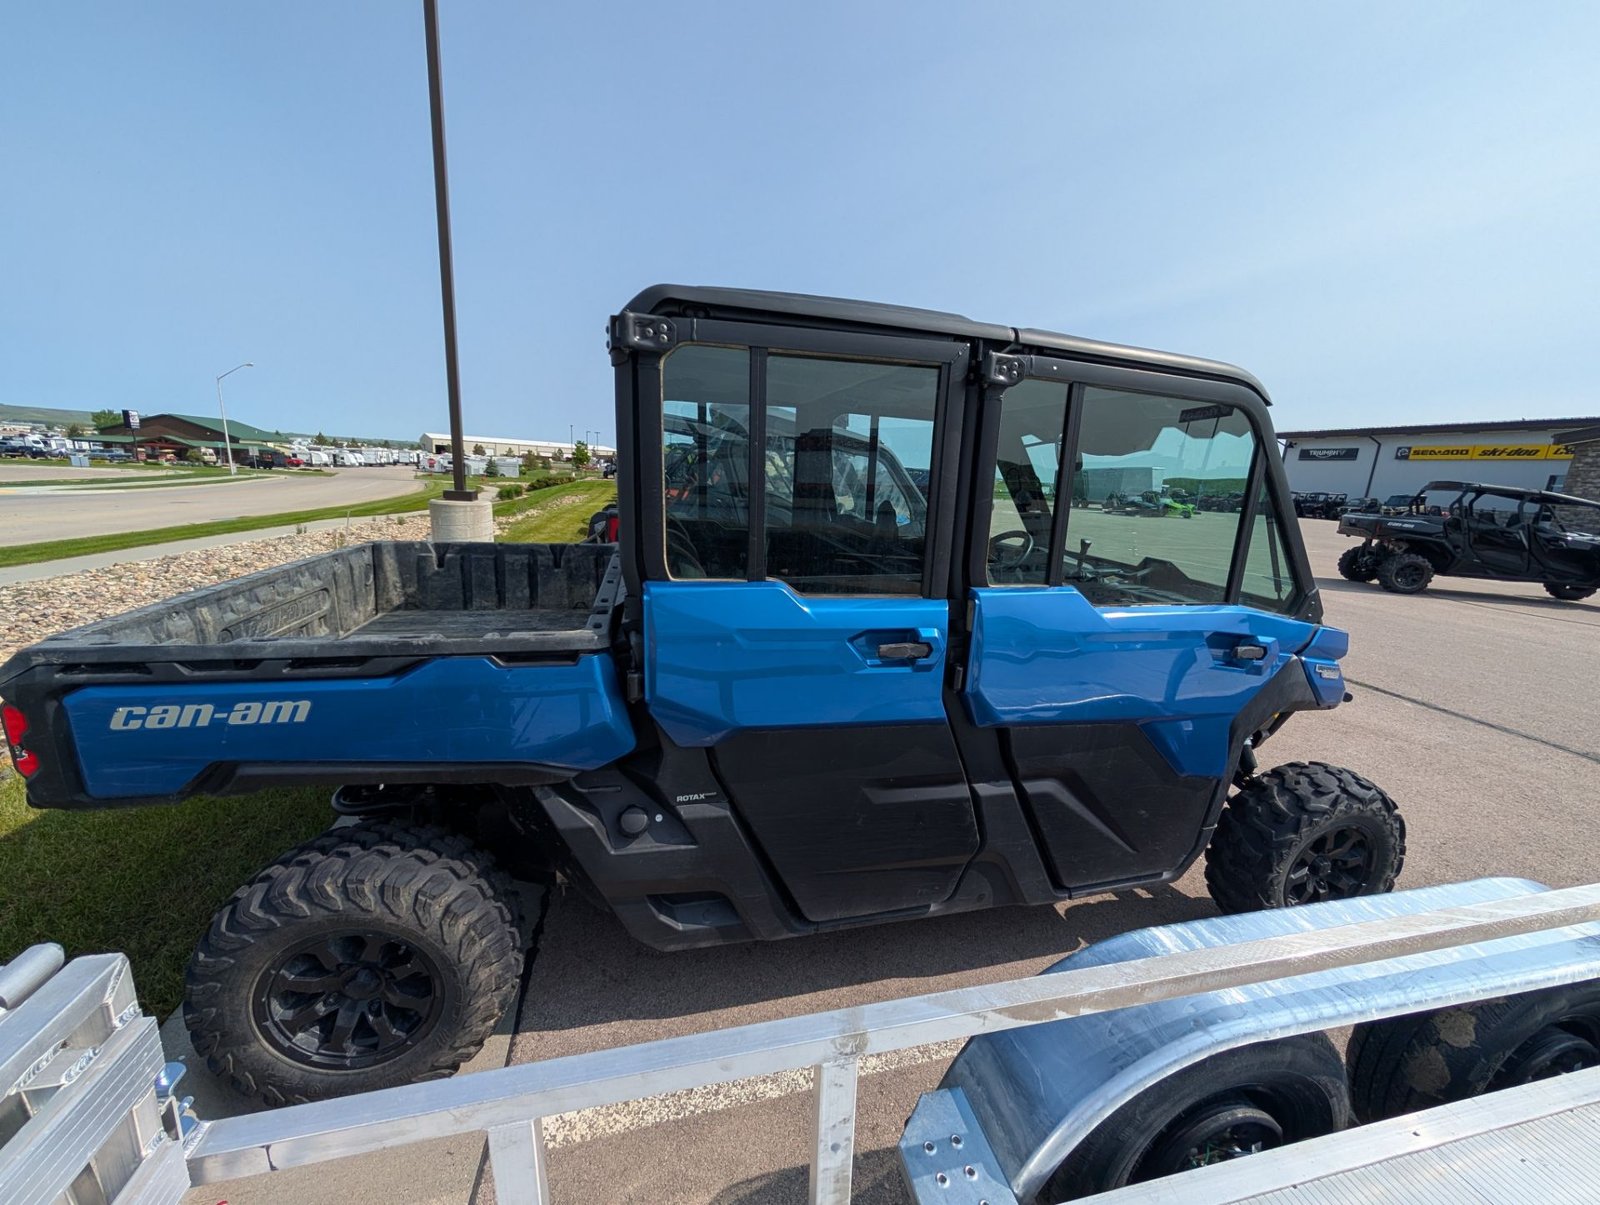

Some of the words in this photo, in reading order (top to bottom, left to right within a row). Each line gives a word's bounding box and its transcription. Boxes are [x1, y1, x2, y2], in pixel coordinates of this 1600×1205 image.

[1478, 447, 1540, 456] ski-doo
[109, 699, 311, 730] can-am
[677, 793, 705, 803] ROTAX
